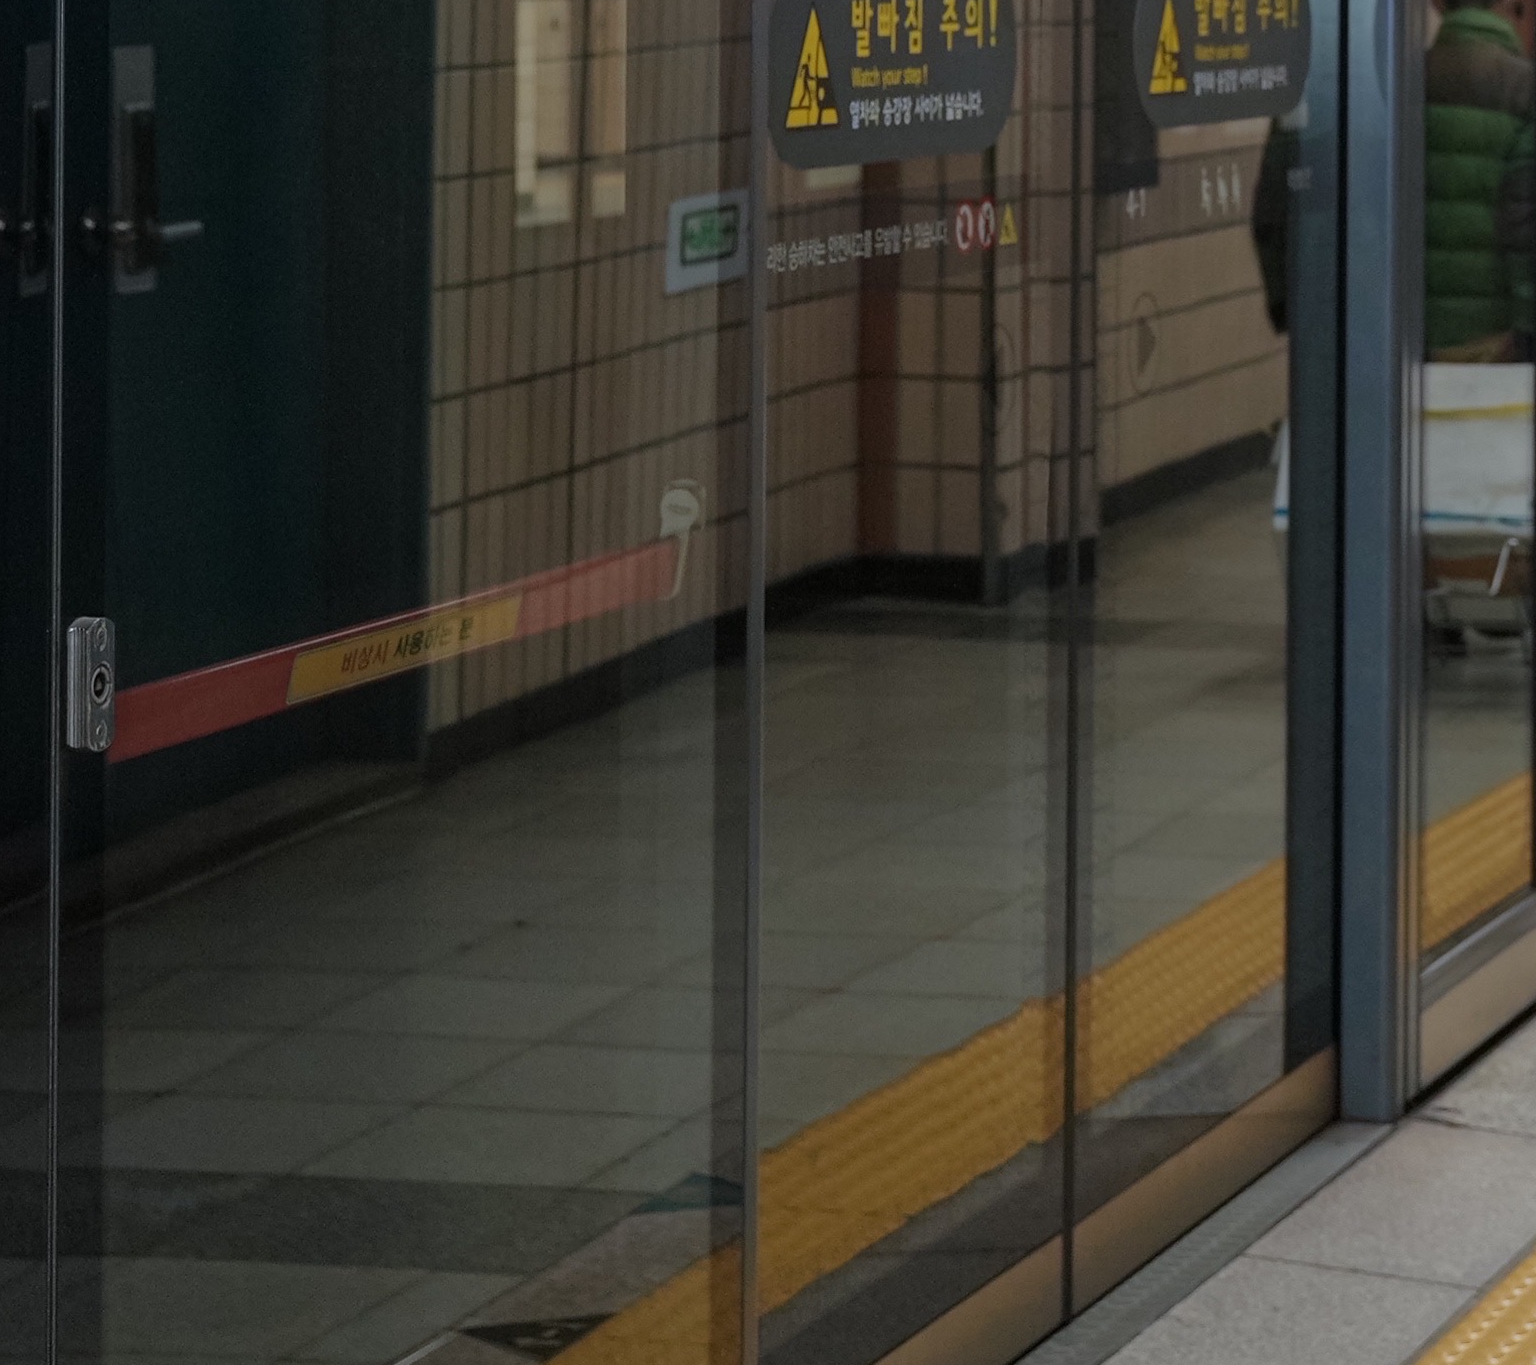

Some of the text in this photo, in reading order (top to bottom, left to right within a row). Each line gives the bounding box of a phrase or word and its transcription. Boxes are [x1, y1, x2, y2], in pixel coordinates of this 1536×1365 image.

[851, 66, 881, 89] Watch
[881, 67, 903, 91] your
[849, 98, 881, 130] 열차와
[882, 94, 913, 128] 승강장
[914, 92, 944, 123] 사이가
[341, 640, 390, 673] 비상시
[393, 624, 453, 657] 사용하는
